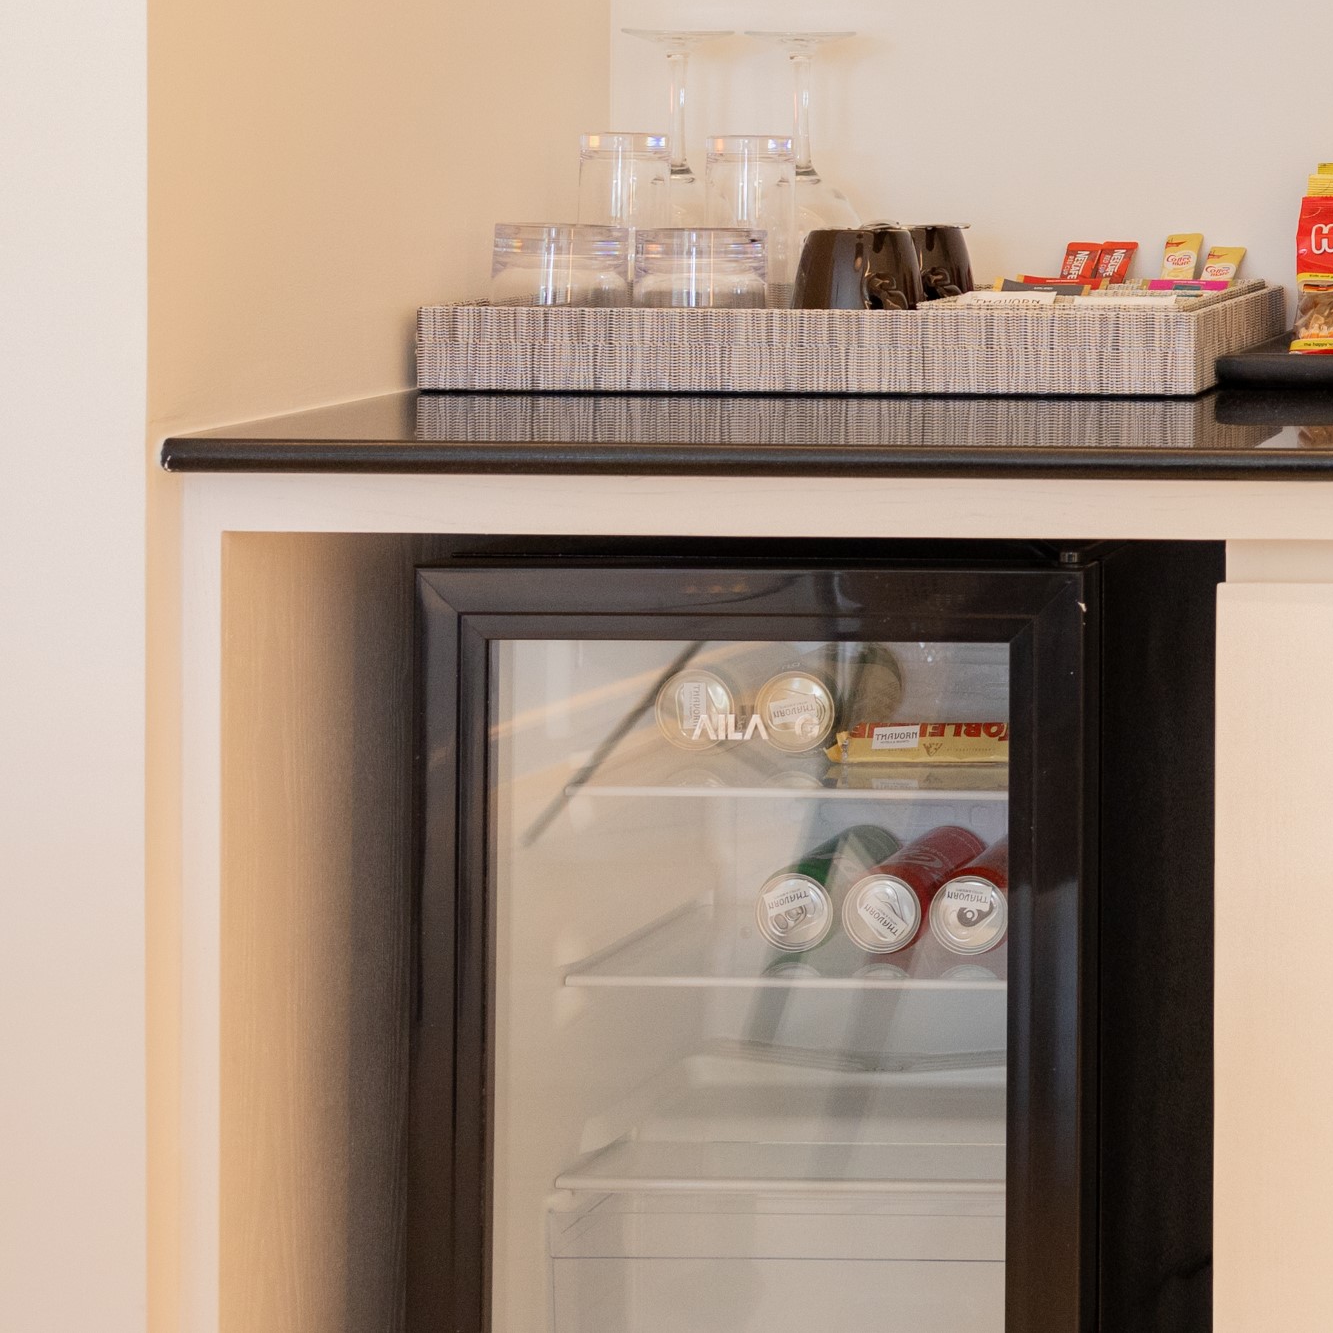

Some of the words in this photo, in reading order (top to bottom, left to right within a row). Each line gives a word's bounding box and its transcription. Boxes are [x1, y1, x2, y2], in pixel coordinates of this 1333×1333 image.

[1166, 254, 1192, 263] Coffee
[1205, 265, 1231, 274] Coffee
[772, 705, 816, 719] THAVORN
[875, 731, 918, 741] THAVORN
[768, 890, 810, 911] THAVORN
[945, 891, 989, 905] THAVORN
[863, 903, 900, 937] THAVORN
